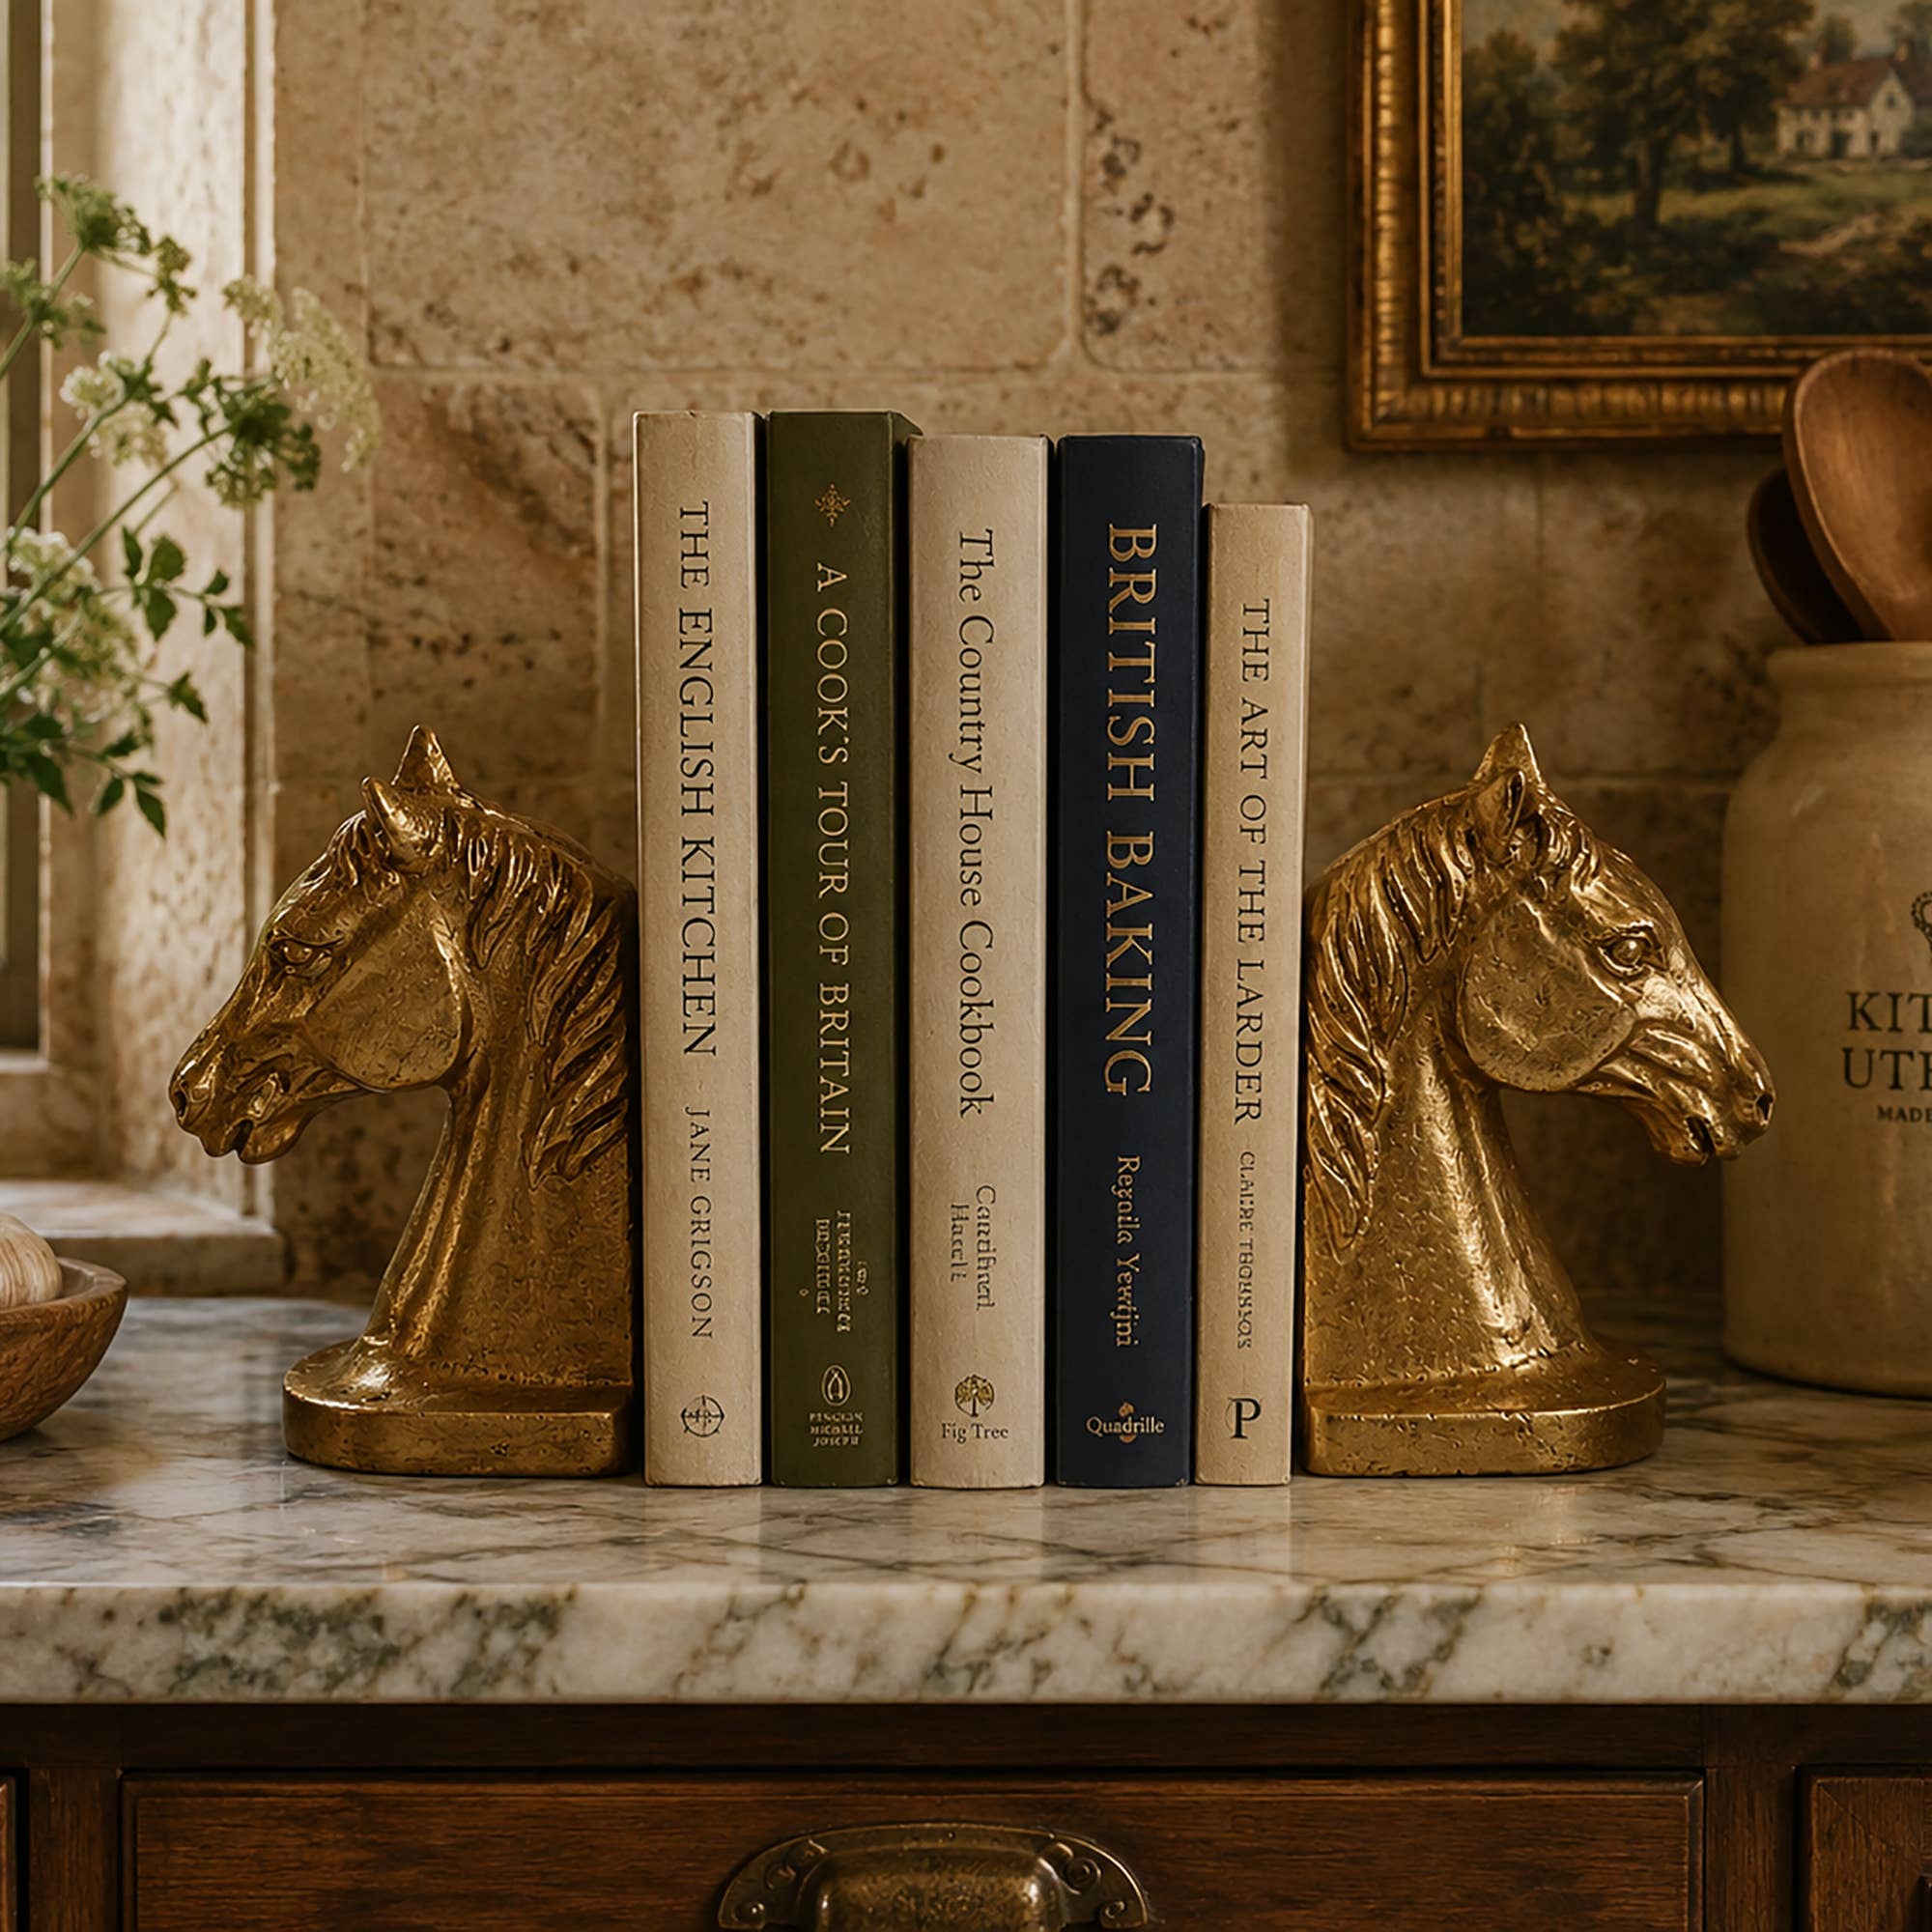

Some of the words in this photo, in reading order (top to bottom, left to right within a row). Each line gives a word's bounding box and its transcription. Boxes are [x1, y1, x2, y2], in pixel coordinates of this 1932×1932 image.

[679, 500, 709, 589] THE
[817, 562, 847, 592] A
[958, 528, 995, 603] The
[817, 608, 850, 764] COOK'S
[1107, 523, 1157, 802] BRITISH
[1241, 598, 1270, 683] THE
[678, 608, 715, 817] ENGLISH
[948, 615, 995, 774] Country
[1239, 696, 1268, 780] ART
[817, 781, 849, 899] TOUR
[959, 783, 993, 907] House
[1238, 794, 1266, 844] OF
[681, 836, 717, 1056] KITCHEN
[818, 912, 849, 966] OF
[1237, 860, 1265, 944] THE
[1104, 830, 1154, 1096] BAKING
[819, 982, 850, 1154] BRITAIN
[959, 920, 995, 1119] Cookbook
[1234, 958, 1264, 1125] LARDER
[685, 1106, 711, 1182] JANE
[690, 1195, 713, 1338] GRIGSON
[941, 1422, 967, 1444] Fig
[970, 1422, 1009, 1439] Tree
[1085, 1414, 1166, 1438] Quadrille
[1227, 1397, 1262, 1439] P
